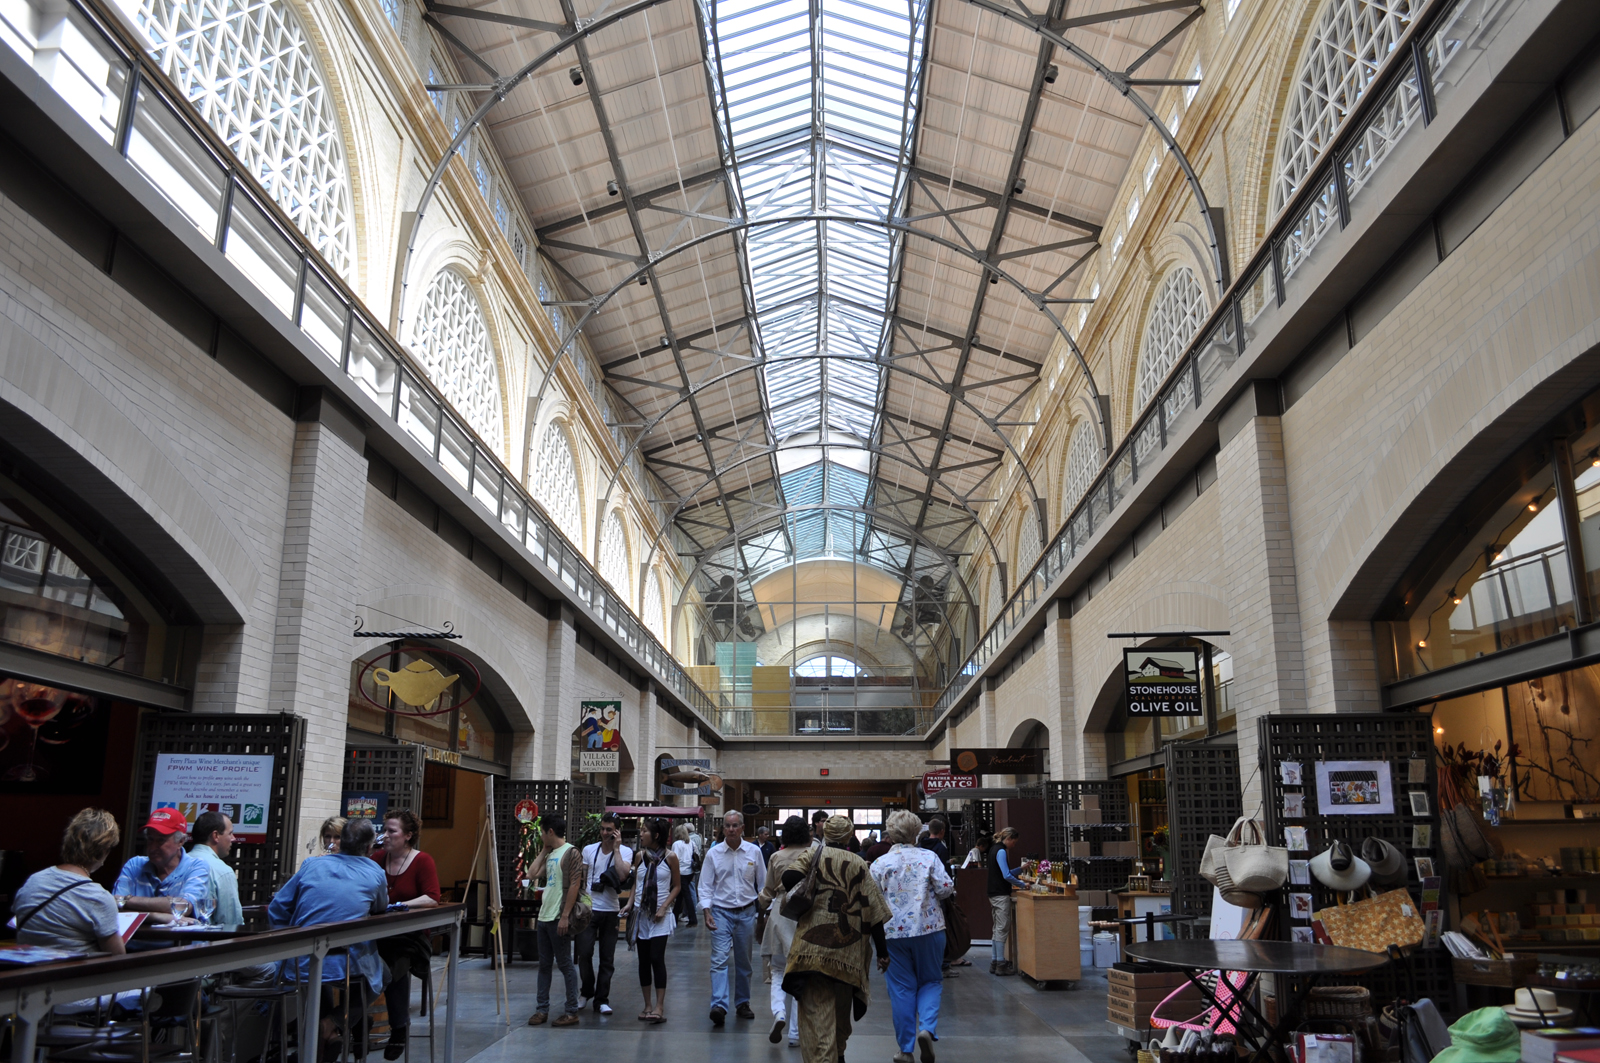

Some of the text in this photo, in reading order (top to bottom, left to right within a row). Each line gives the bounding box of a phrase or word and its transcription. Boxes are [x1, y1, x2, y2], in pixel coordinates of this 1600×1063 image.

[1129, 685, 1197, 694] STONEHOUSE
[1130, 702, 1199, 712] OLIVE OIL
[170, 757, 183, 765] Ferry
[661, 759, 710, 768] SAN FRANCISCO
[927, 780, 957, 788] MEAT
[661, 784, 709, 794] FISH COMPANY
